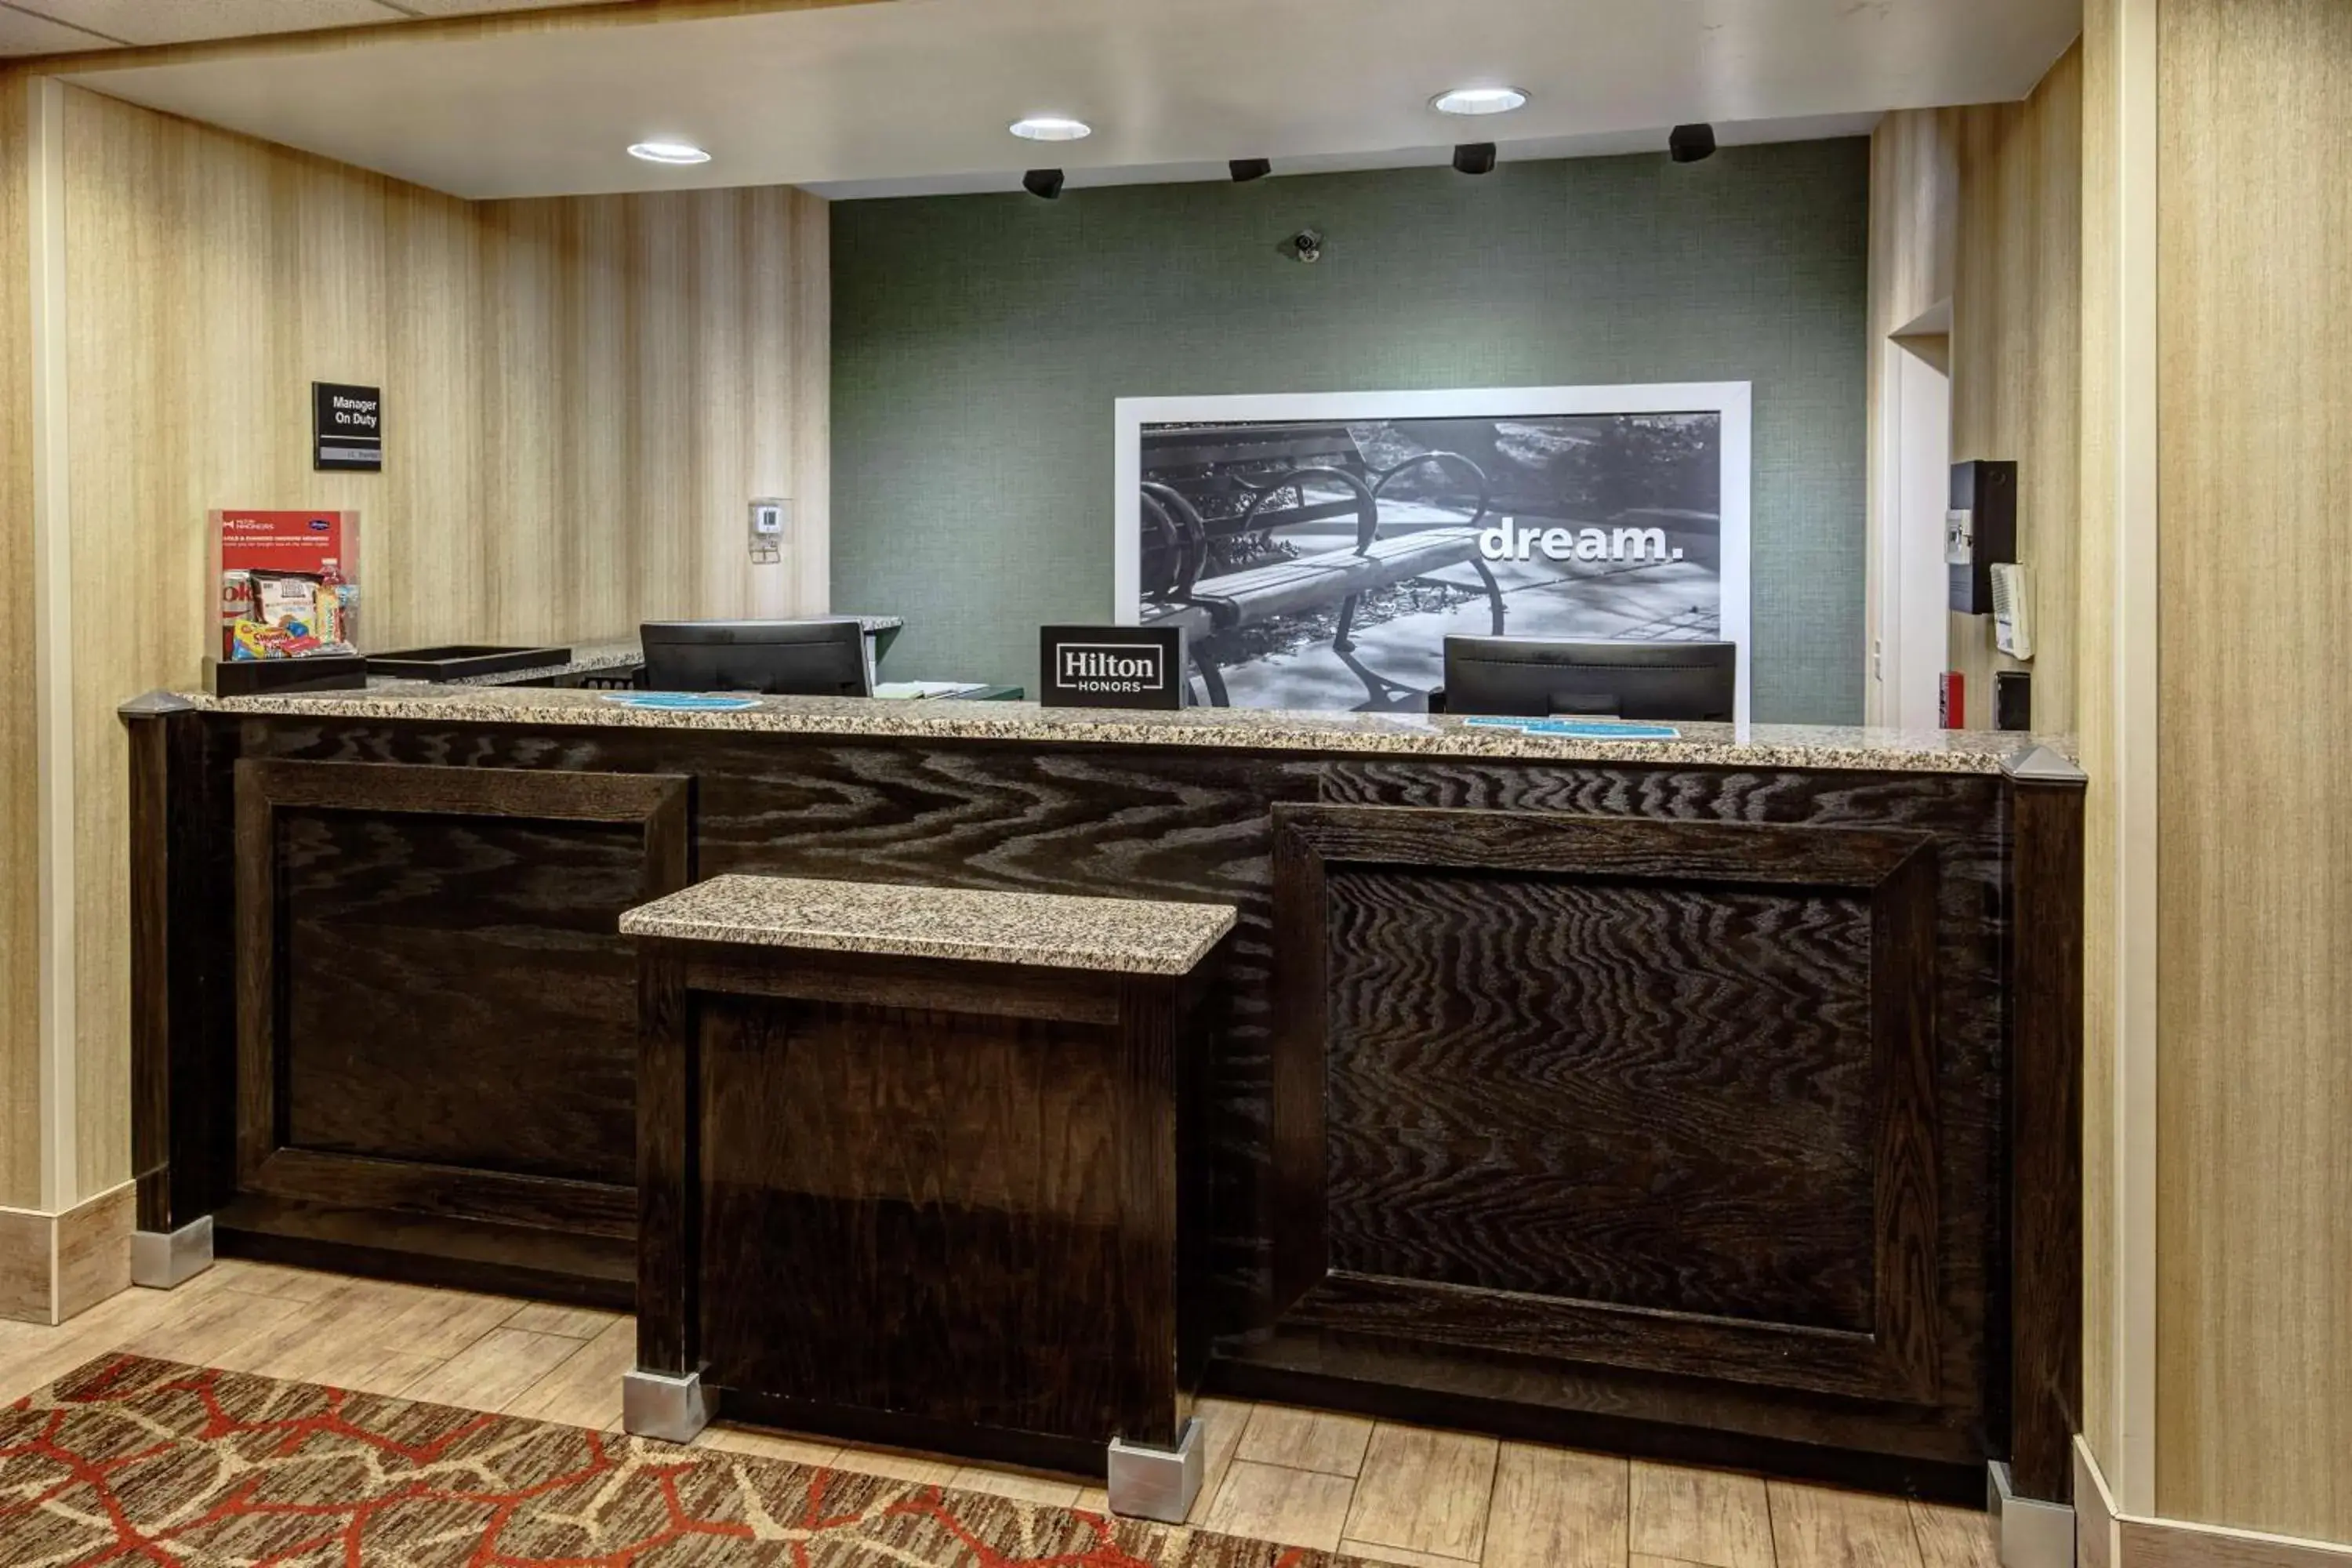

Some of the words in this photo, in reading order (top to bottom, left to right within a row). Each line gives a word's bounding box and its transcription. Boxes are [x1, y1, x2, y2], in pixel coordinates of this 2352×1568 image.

[333, 395, 376, 412] Manager
[335, 411, 350, 424] On
[353, 412, 376, 429] Duty
[1479, 517, 1683, 561] dream.
[1065, 652, 1154, 677] Hilton
[1078, 681, 1142, 692] HONORS
